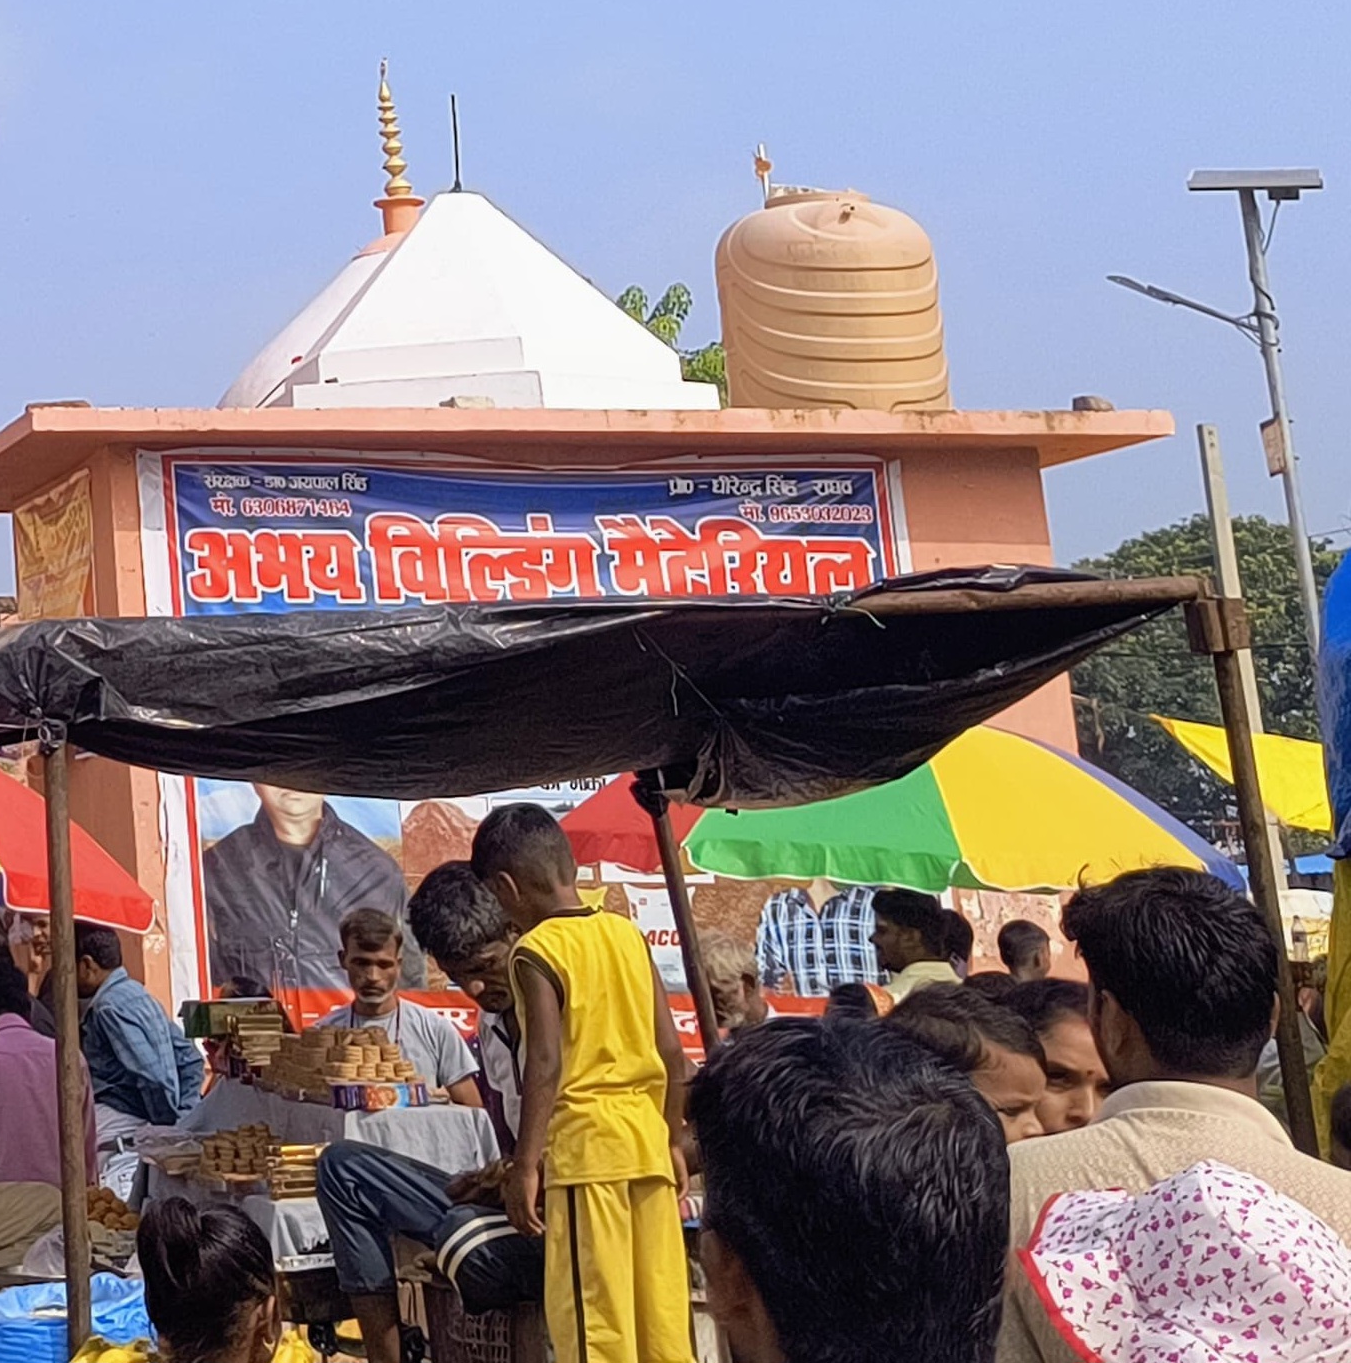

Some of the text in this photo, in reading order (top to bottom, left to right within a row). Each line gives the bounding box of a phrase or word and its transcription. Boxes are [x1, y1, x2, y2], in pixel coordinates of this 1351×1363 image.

[289, 475, 340, 491] जयपाल
[342, 473, 368, 492] सिंह
[766, 474, 798, 497] सिंह
[812, 479, 853, 496] राघव
[768, 504, 873, 524] 9653032023
[187, 529, 364, 604] अभय
